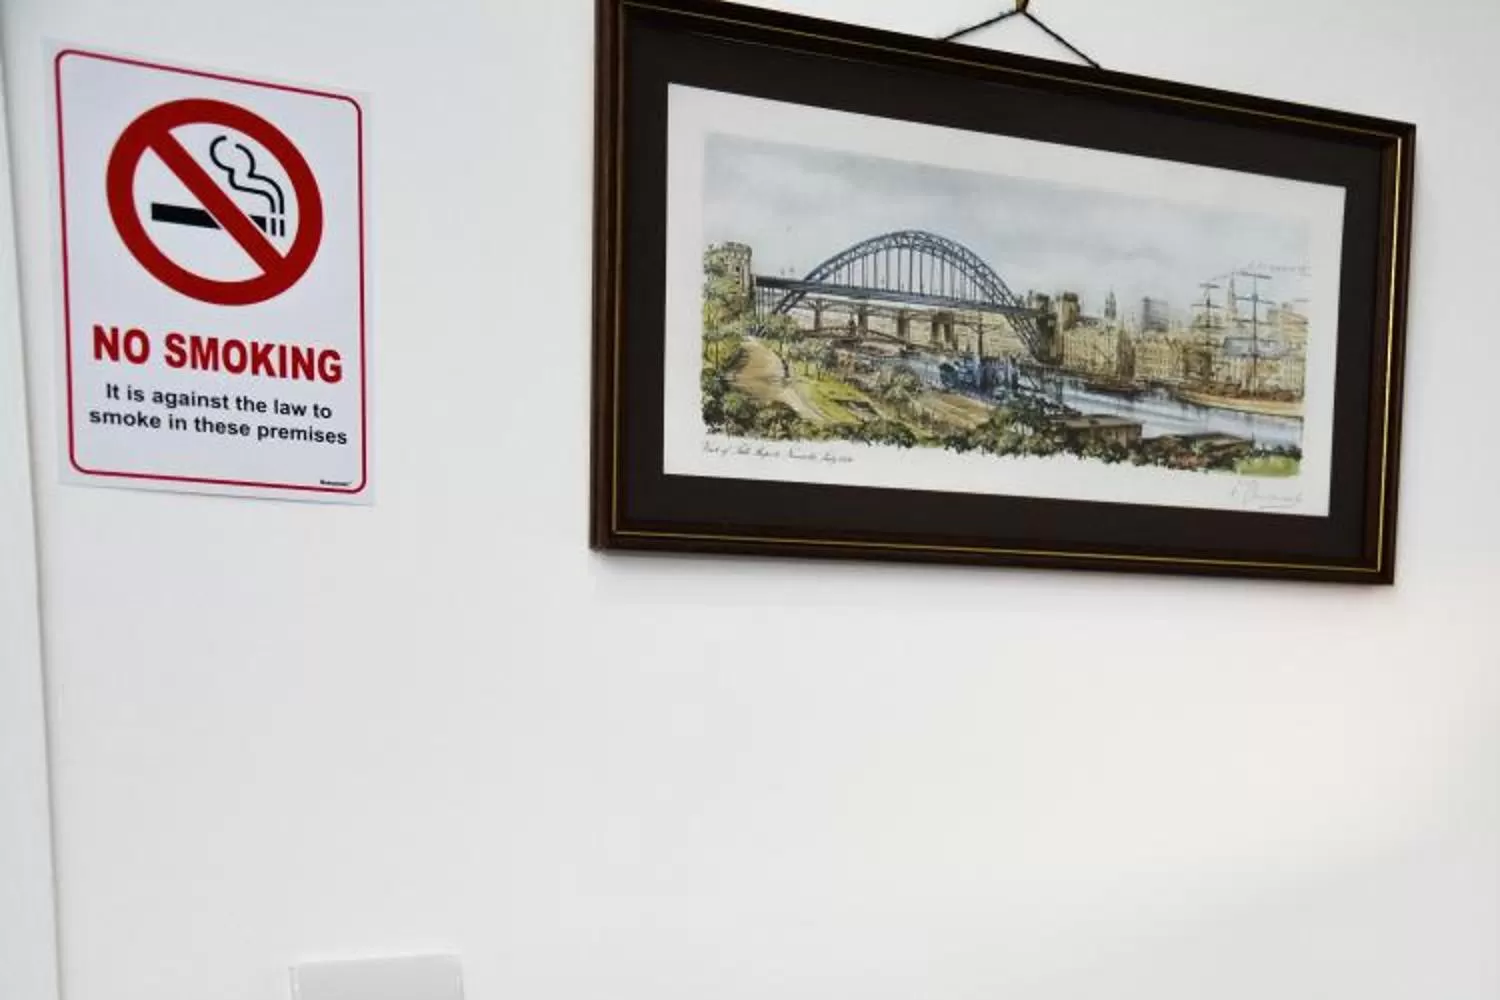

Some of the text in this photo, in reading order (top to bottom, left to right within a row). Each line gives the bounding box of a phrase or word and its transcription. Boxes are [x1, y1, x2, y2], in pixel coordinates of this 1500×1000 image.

[93, 325, 343, 384] NO SMOKING
[106, 384, 332, 419] It is against the law to
[89, 410, 347, 446] smoke in these premises
